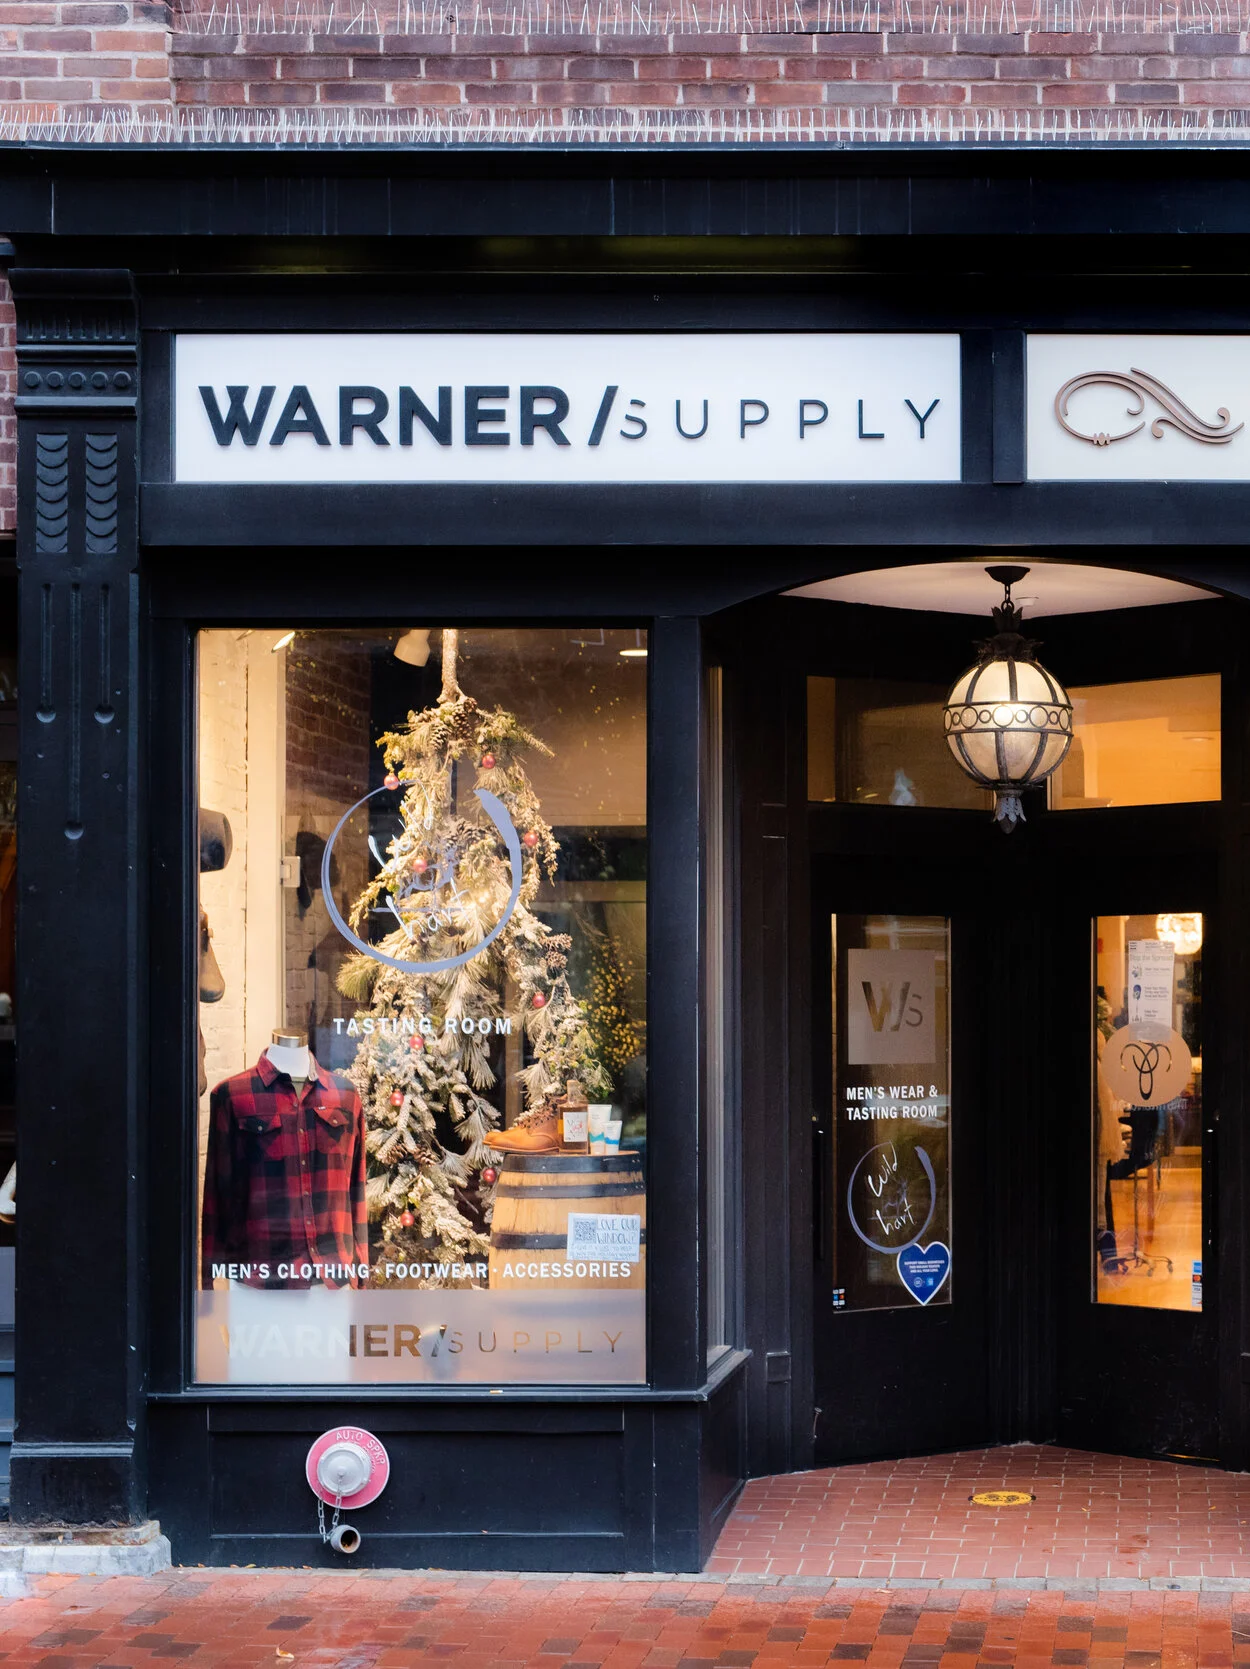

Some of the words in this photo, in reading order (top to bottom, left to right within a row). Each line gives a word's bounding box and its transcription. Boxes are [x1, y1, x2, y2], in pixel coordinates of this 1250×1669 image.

[333, 1017, 432, 1036] TASTING
[445, 1017, 512, 1035] ROOM
[846, 1086, 885, 1100] MEN'S
[889, 1085, 925, 1099] WEAR
[929, 1085, 938, 1098] &
[846, 1106, 898, 1121] TASTING
[902, 1105, 937, 1119] ROOM
[211, 1263, 270, 1279] MEN'S
[277, 1263, 369, 1279] CLOTHING
[385, 1262, 487, 1279] FOOTWEAR
[503, 1262, 631, 1279] ACCESSORIES
[336, 1430, 363, 1441] AUTO
[366, 1440, 386, 1465] SPKR
